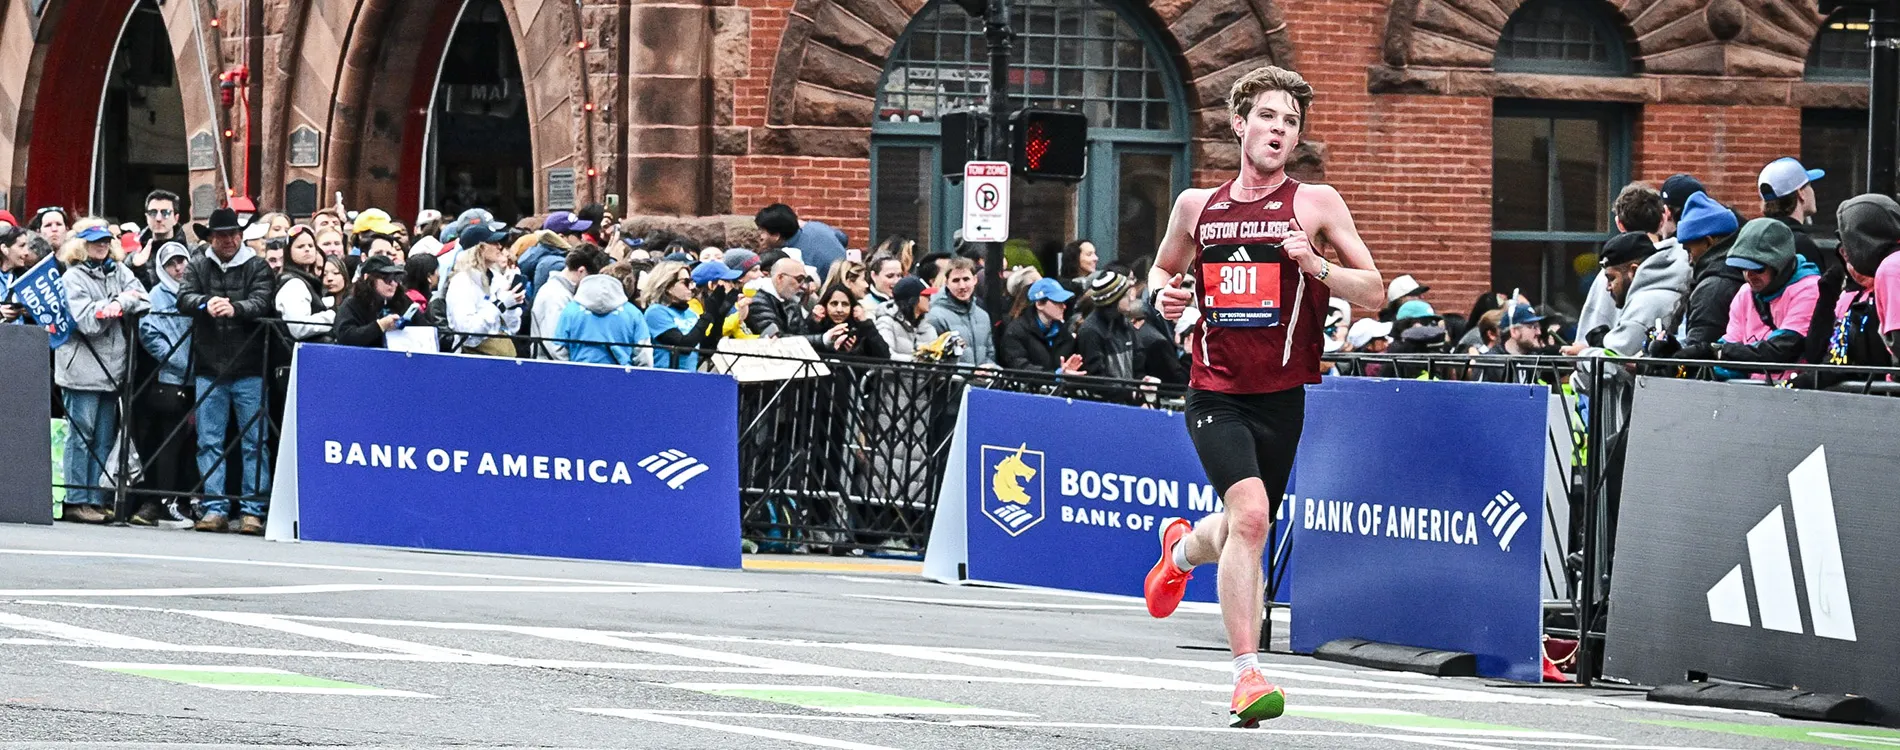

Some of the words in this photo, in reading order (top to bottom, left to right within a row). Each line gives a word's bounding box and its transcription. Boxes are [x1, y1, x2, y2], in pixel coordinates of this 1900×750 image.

[968, 165, 985, 175] TOW
[985, 165, 1007, 176] ZONE
[1200, 222, 1240, 240] BOSTON
[1240, 221, 1290, 238] COLLEGE
[1220, 265, 1257, 295] 301
[325, 441, 417, 469] BANK
[427, 449, 469, 472] OF
[478, 453, 631, 484] AMERICA
[1060, 468, 1179, 508] BOSTON
[1062, 506, 1121, 527] BANK
[1127, 514, 1153, 531] OF
[1305, 499, 1353, 533] BANK
[1359, 503, 1382, 535] OF
[1386, 506, 1477, 544] AMERICA
